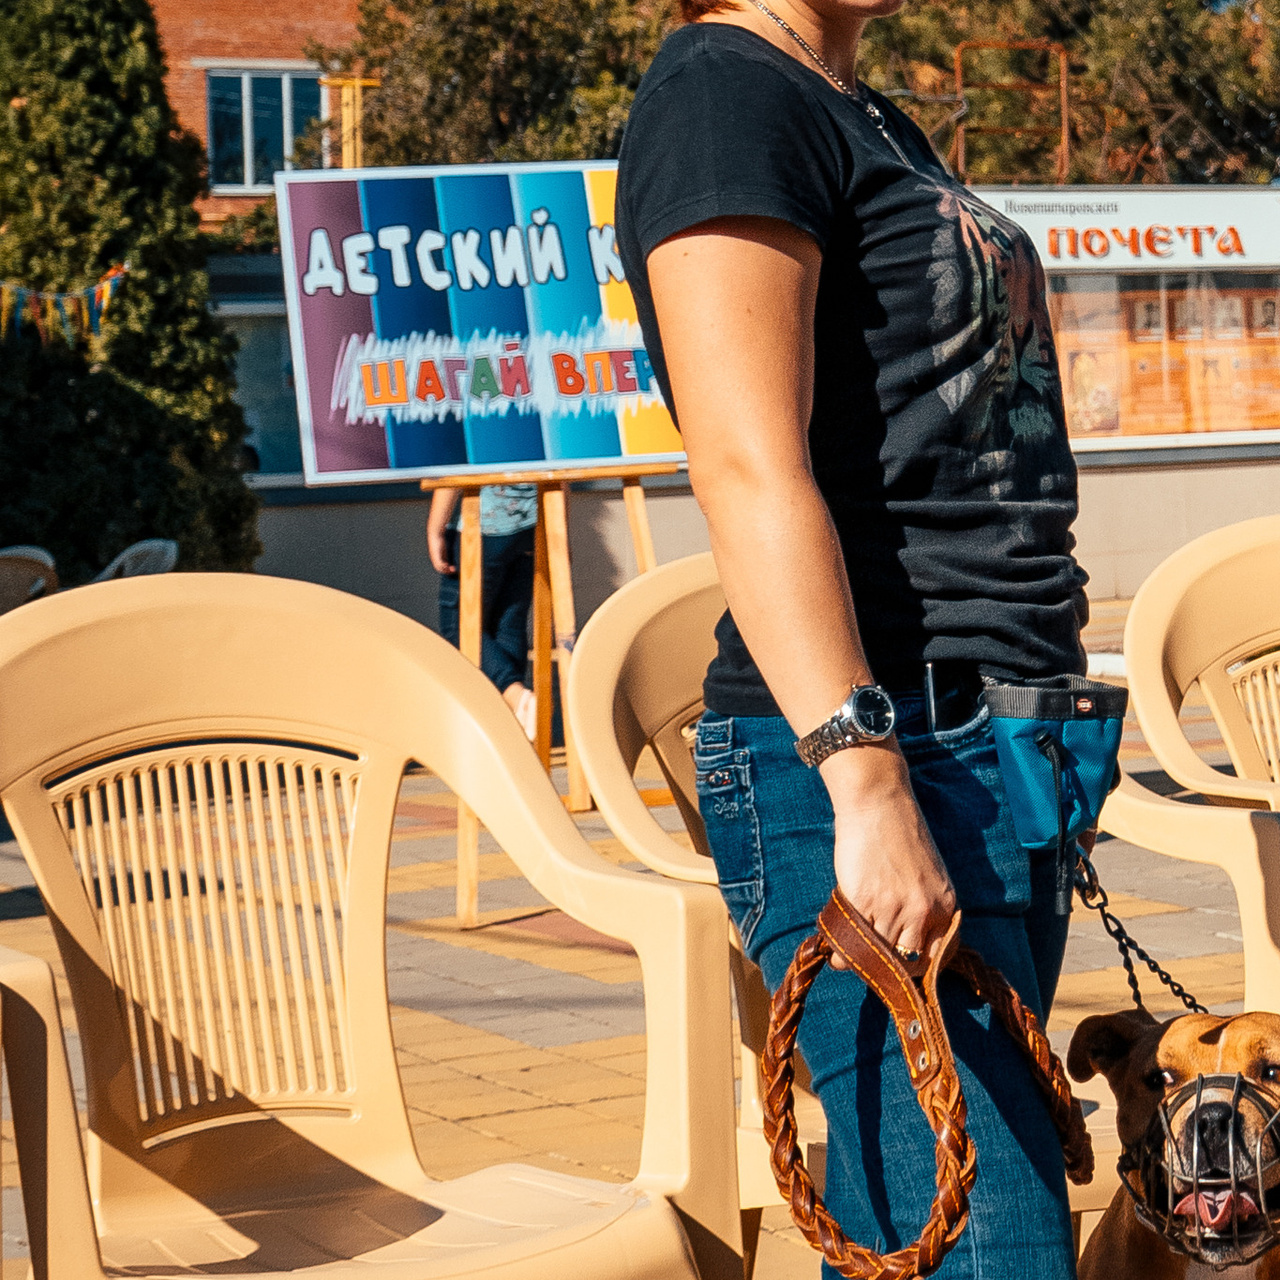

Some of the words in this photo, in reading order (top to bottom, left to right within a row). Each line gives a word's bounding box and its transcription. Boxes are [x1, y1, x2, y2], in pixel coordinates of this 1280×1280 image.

[302, 207, 568, 296] ДЕТСКИЙ
[1047, 224, 1245, 258] ПОЧЕТА
[360, 341, 533, 406] ШАГАЙ
